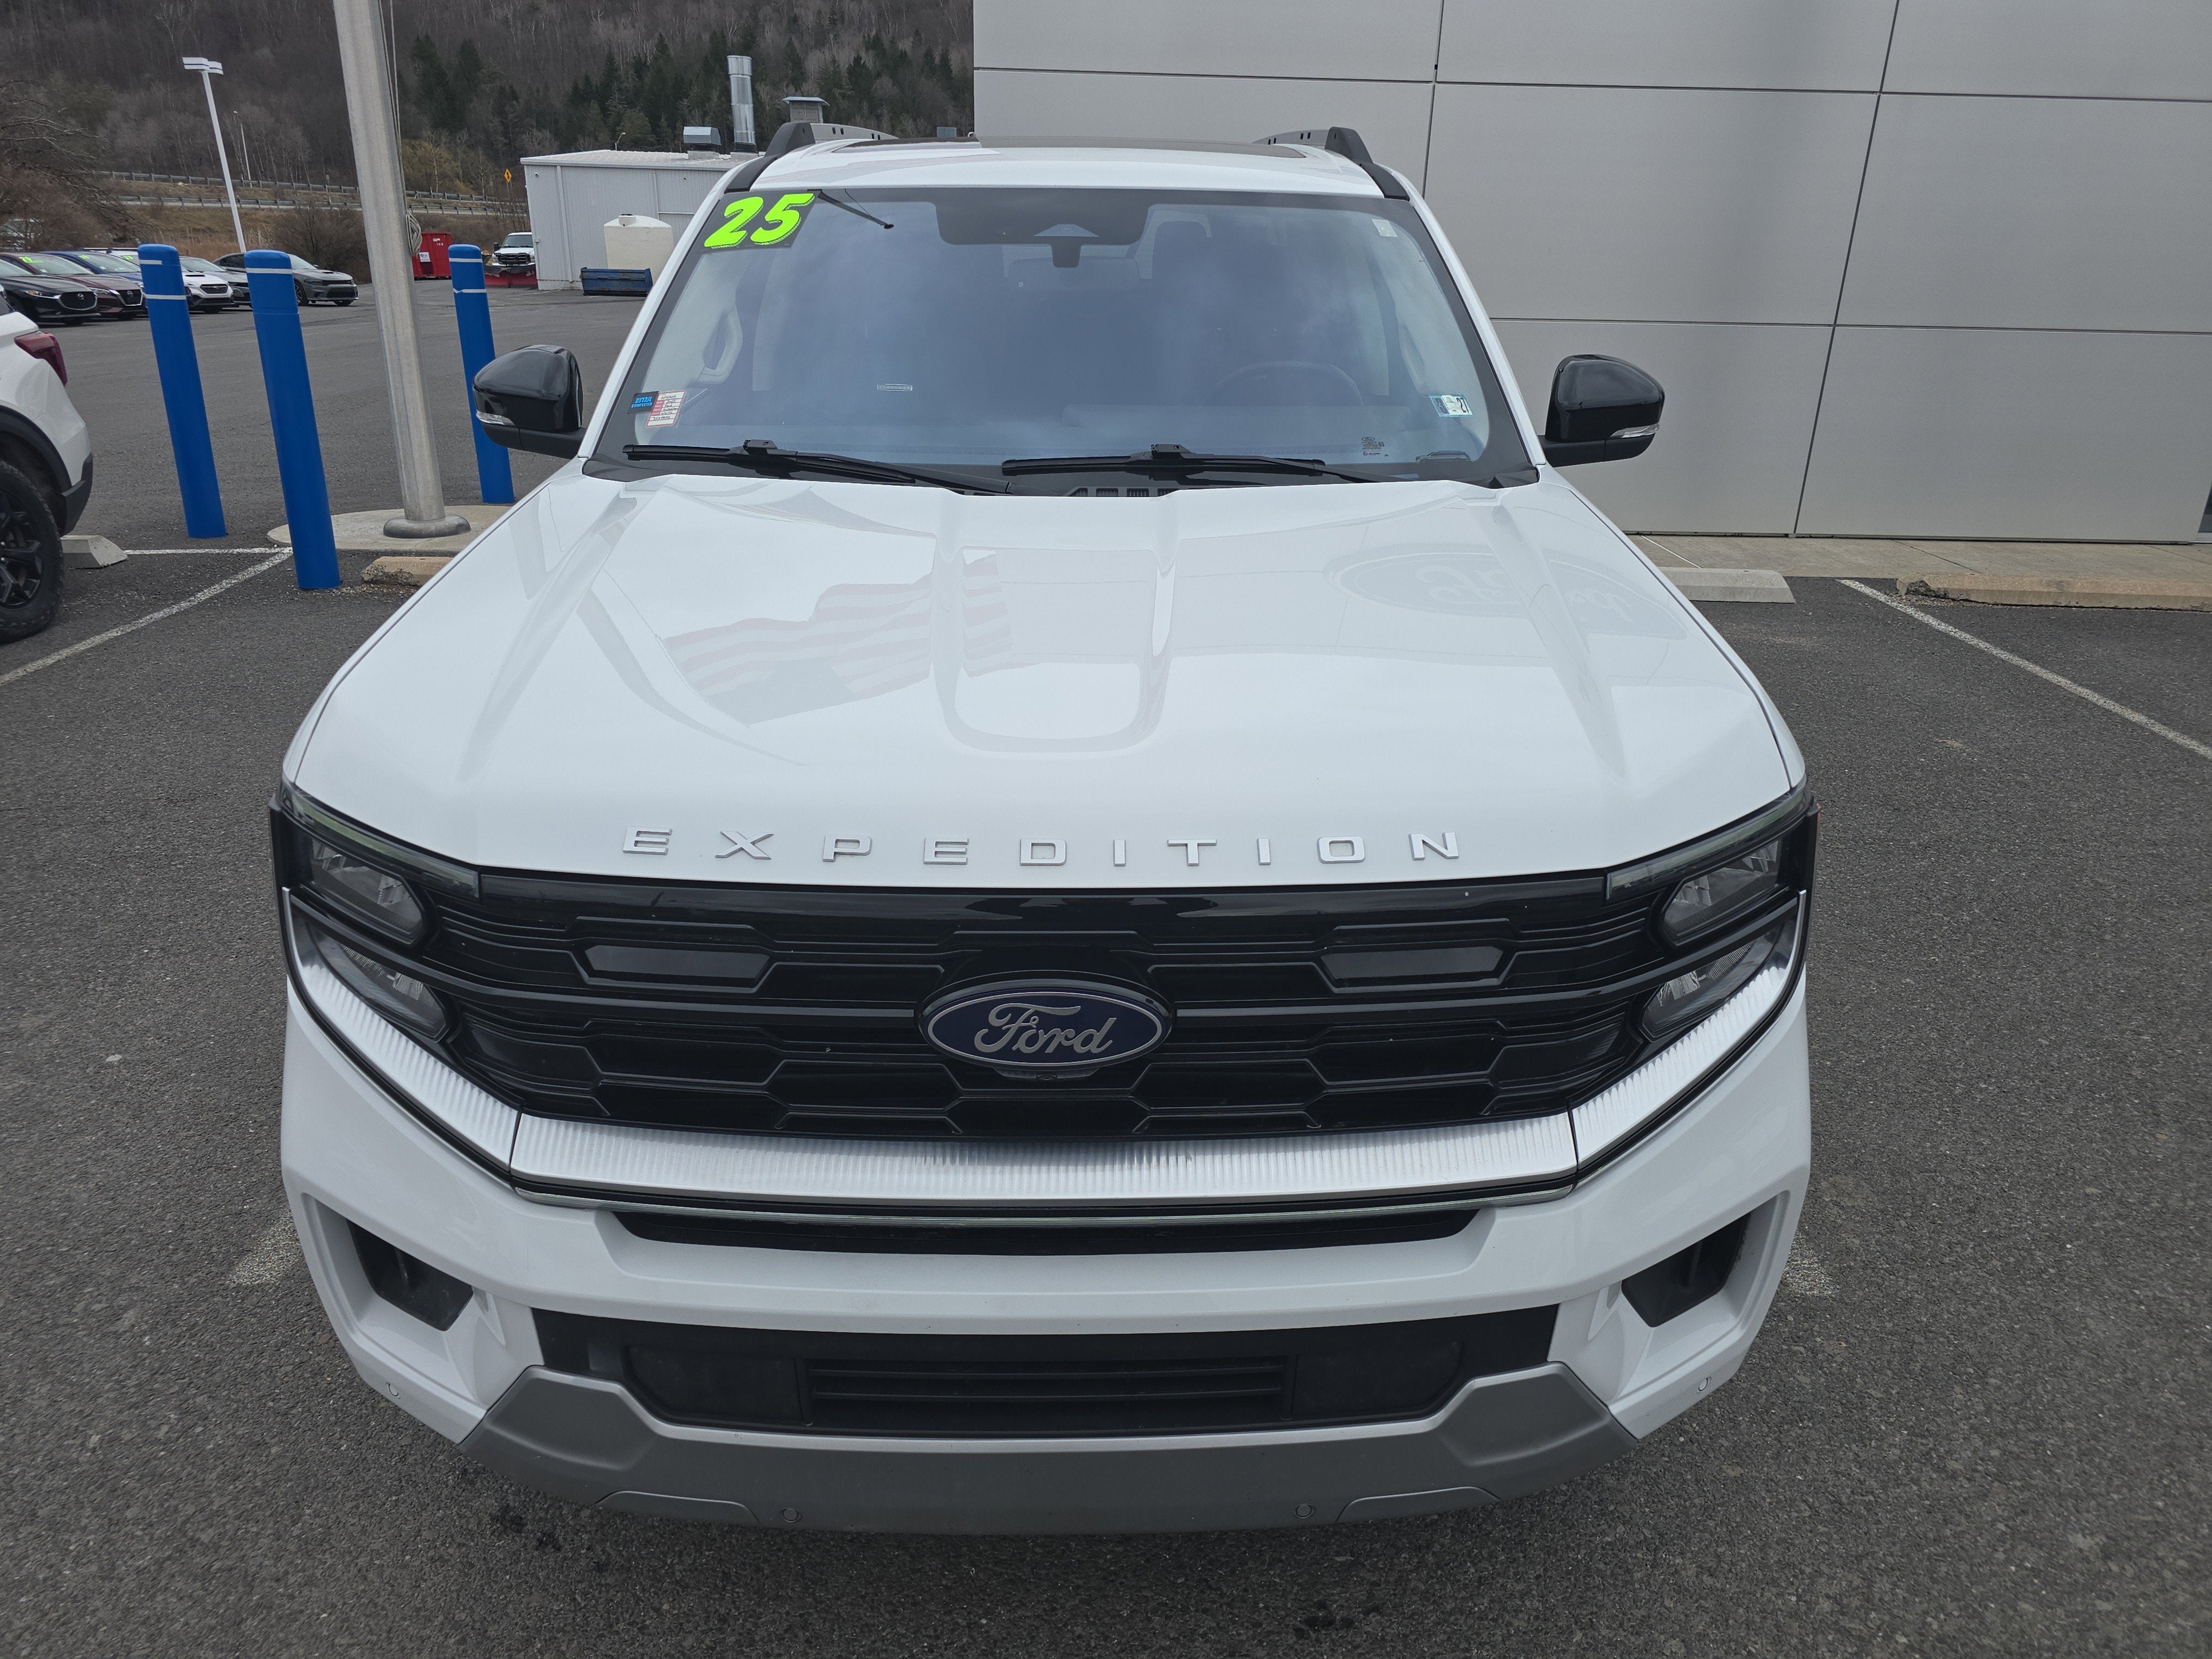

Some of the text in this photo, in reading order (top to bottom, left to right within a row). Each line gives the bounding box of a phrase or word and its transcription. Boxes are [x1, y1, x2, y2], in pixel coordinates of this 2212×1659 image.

[704, 192, 815, 249] 25
[1456, 397, 1469, 414] 27
[623, 826, 1459, 867] EXPEDITION
[974, 1003, 1117, 1053] Ford
